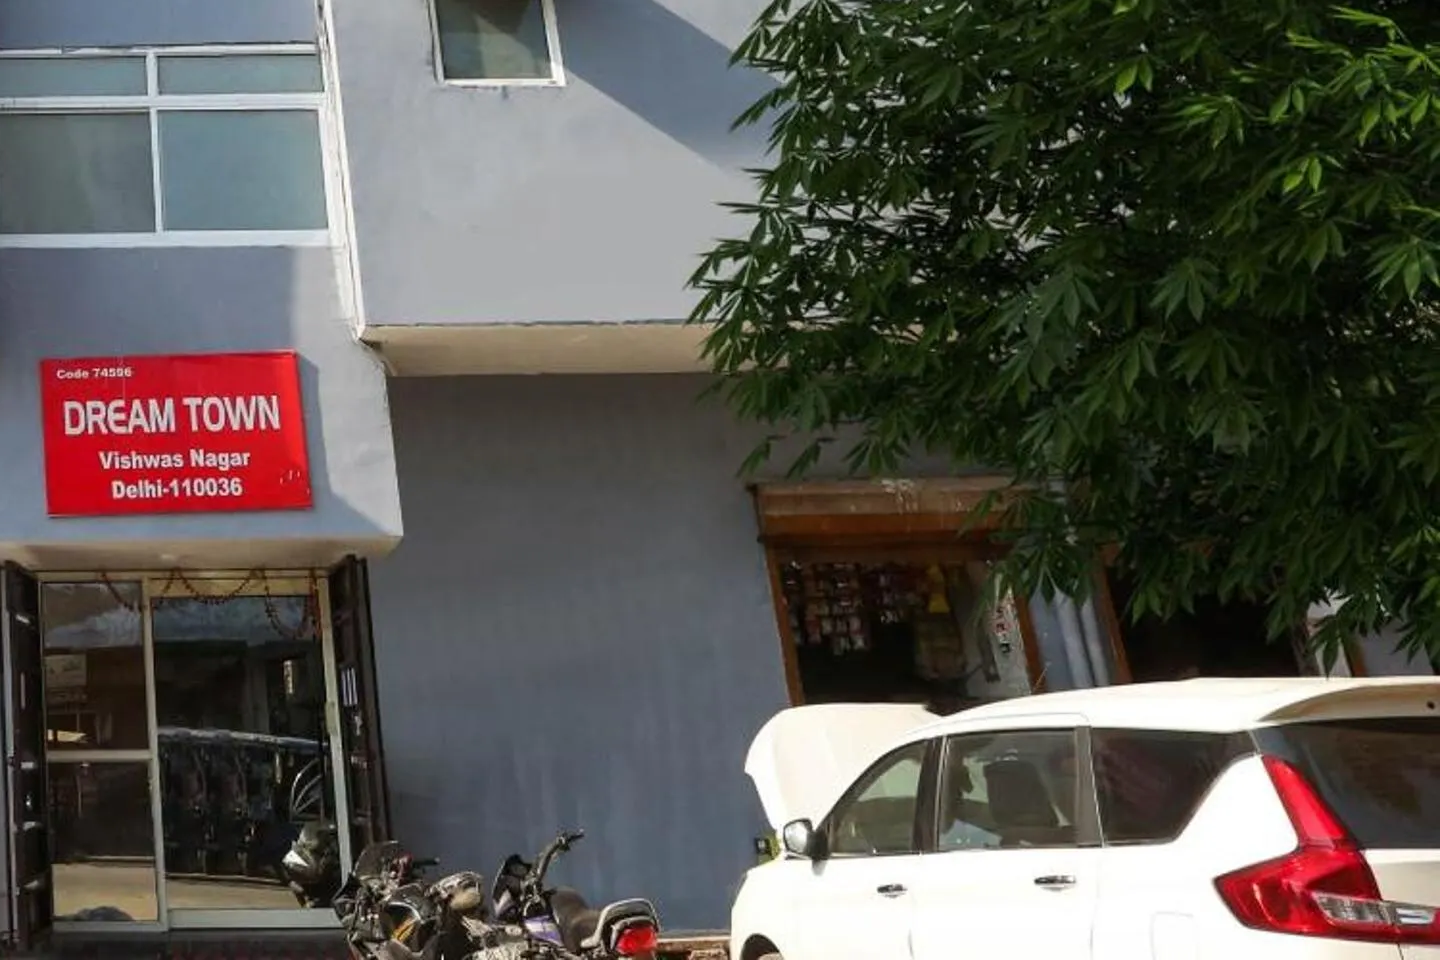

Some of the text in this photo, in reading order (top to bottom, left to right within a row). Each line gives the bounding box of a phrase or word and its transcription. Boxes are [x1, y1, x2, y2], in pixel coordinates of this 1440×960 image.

[56, 368, 89, 379] Code
[63, 395, 281, 435] DREAM TOWN
[99, 449, 250, 470] Vishwas Nagar
[111, 477, 243, 499] Delhi-110036
